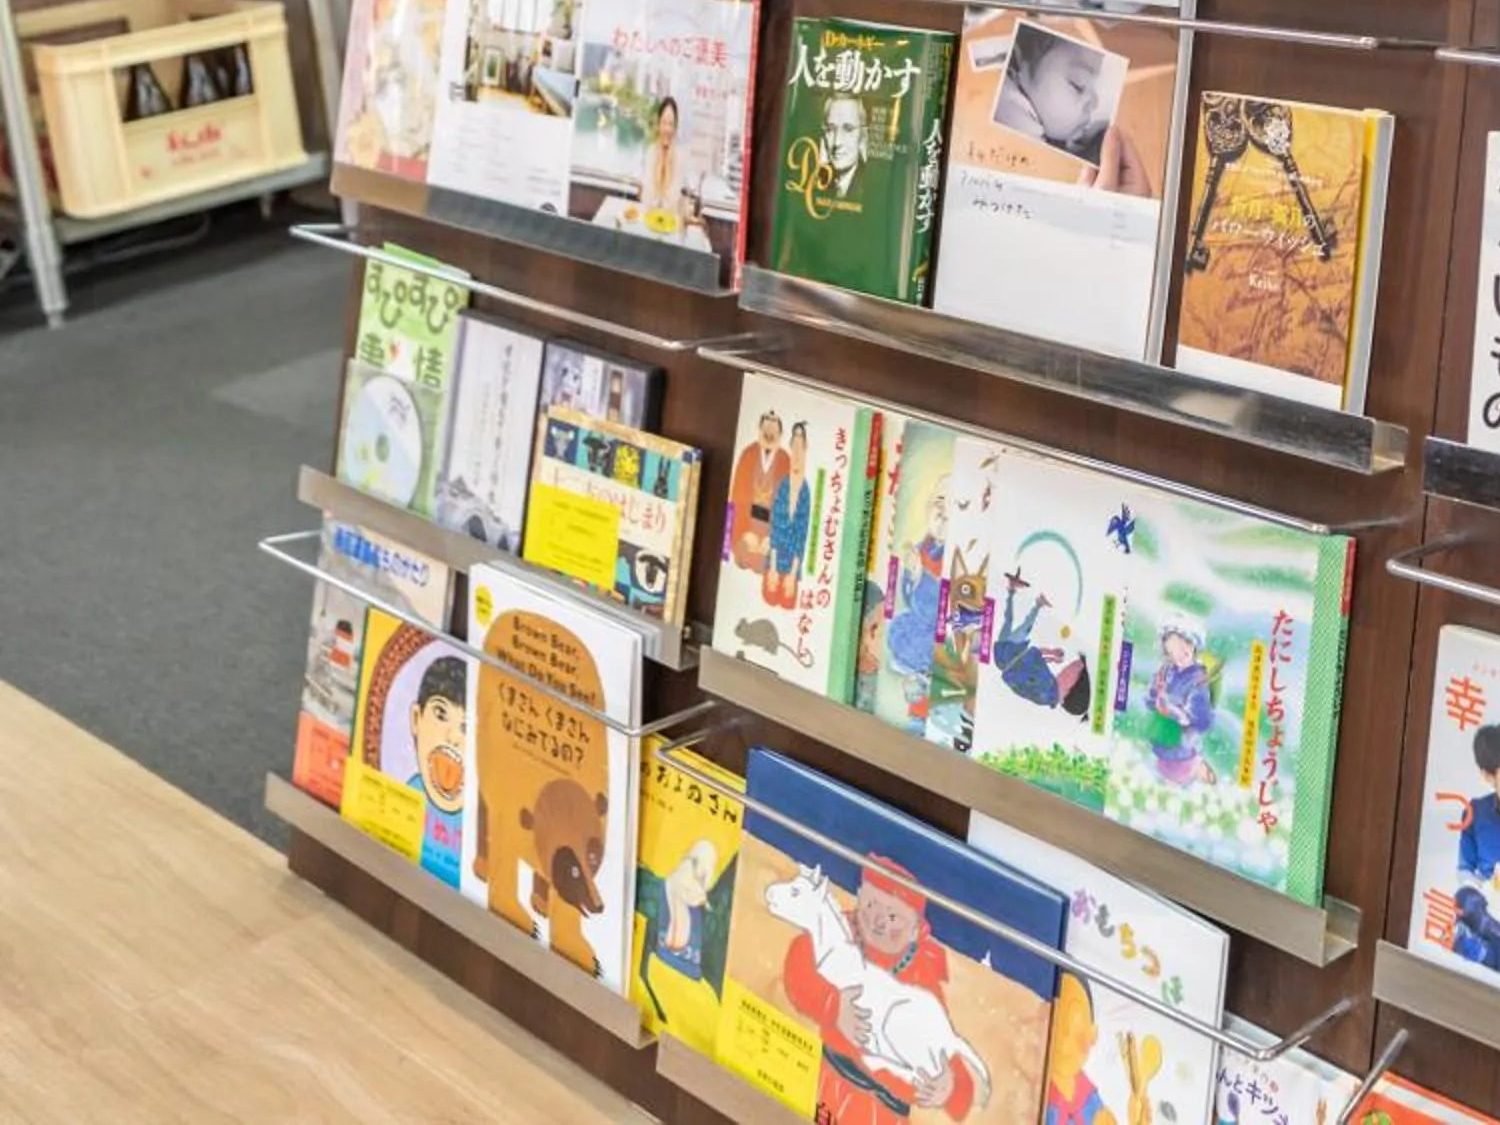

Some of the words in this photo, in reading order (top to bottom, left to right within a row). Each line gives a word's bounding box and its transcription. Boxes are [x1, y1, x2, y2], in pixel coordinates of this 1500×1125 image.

[788, 42, 922, 98] 人を動かす
[1257, 608, 1296, 835] たにしちょうじゃ
